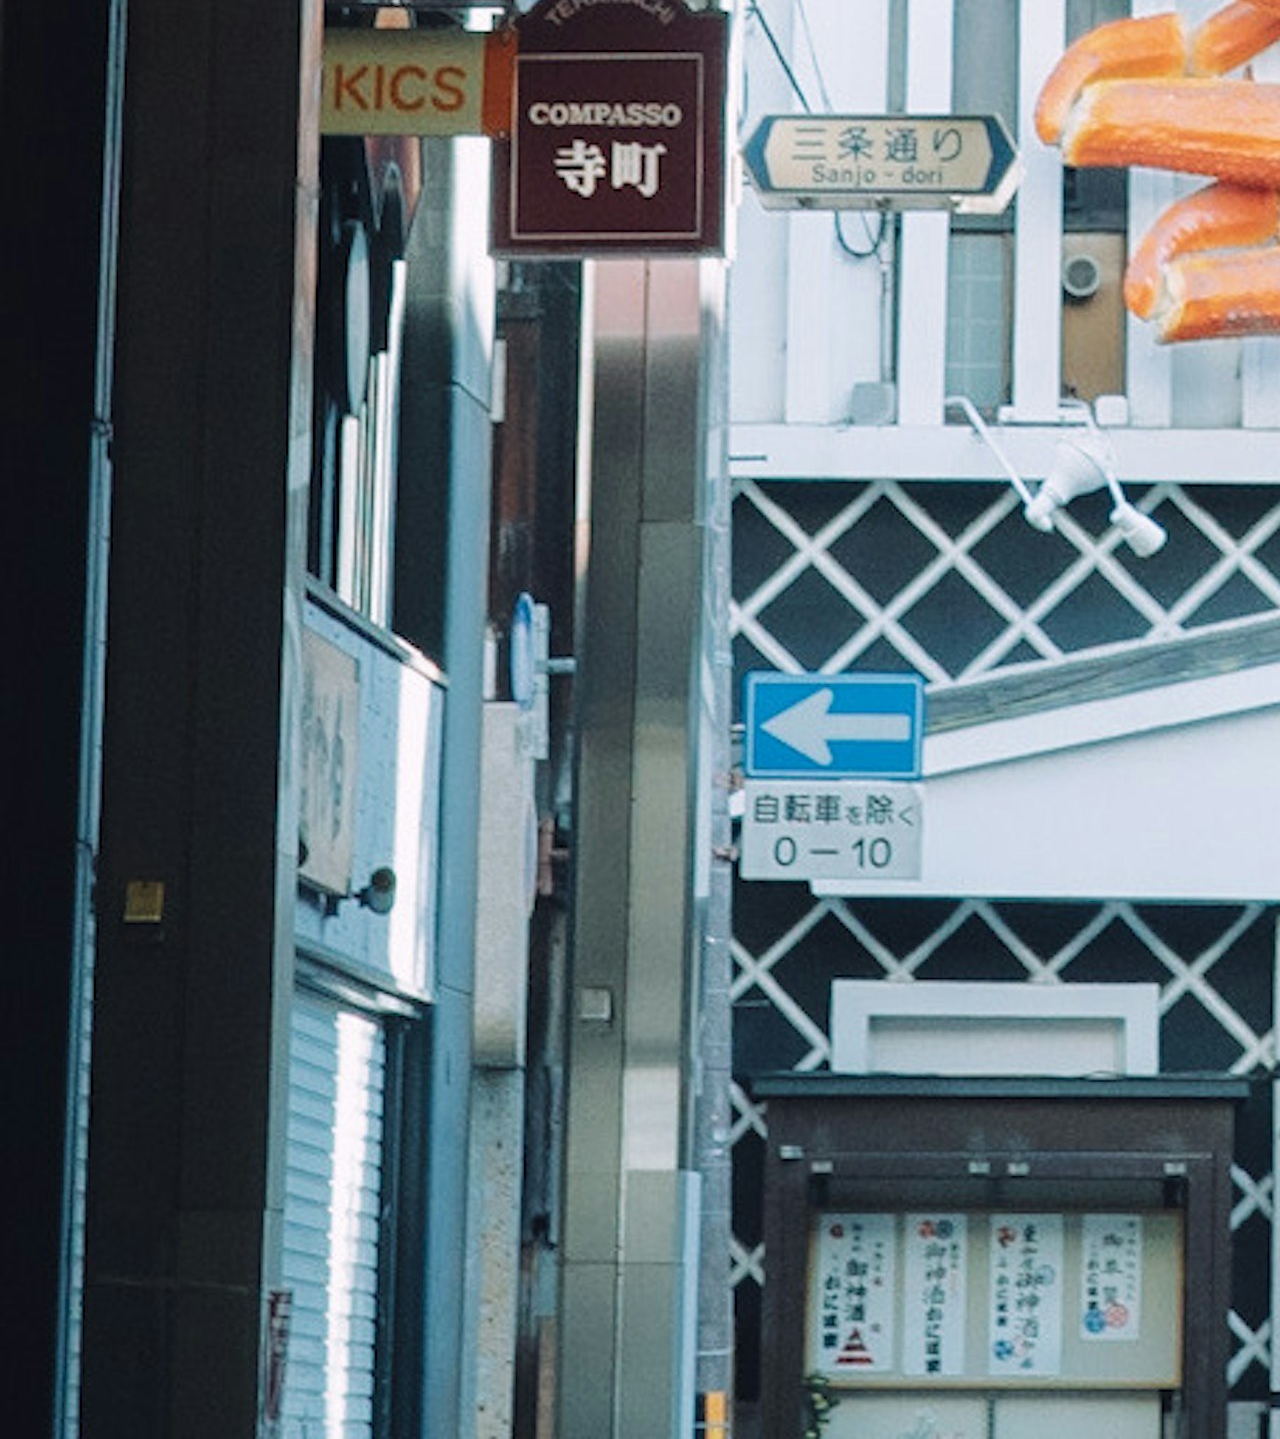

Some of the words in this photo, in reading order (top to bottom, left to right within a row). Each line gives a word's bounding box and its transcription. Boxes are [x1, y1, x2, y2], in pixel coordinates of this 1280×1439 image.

[333, 64, 468, 112] KICS
[528, 101, 684, 128] COMPASSO
[790, 125, 963, 163] 三条通り
[552, 138, 668, 199] 寺町
[754, 794, 915, 827] 自転車を除く
